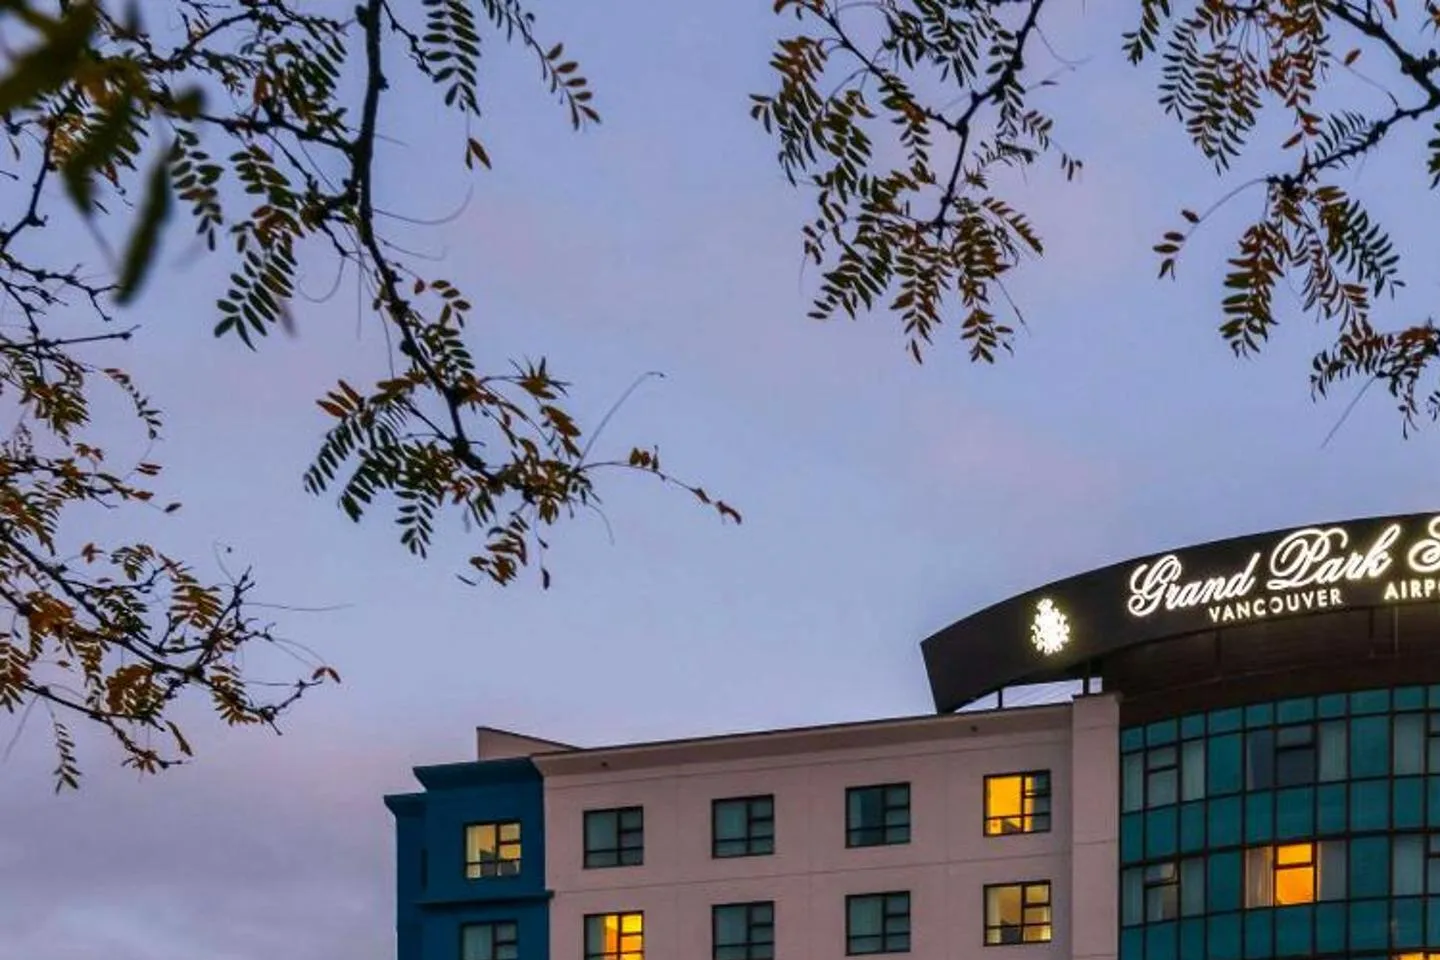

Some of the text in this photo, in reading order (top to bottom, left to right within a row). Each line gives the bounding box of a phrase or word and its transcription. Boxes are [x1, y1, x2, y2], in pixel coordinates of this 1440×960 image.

[1128, 552, 1262, 618] Grand
[1266, 525, 1401, 591] Park
[1208, 588, 1344, 623] VANCOUVER
